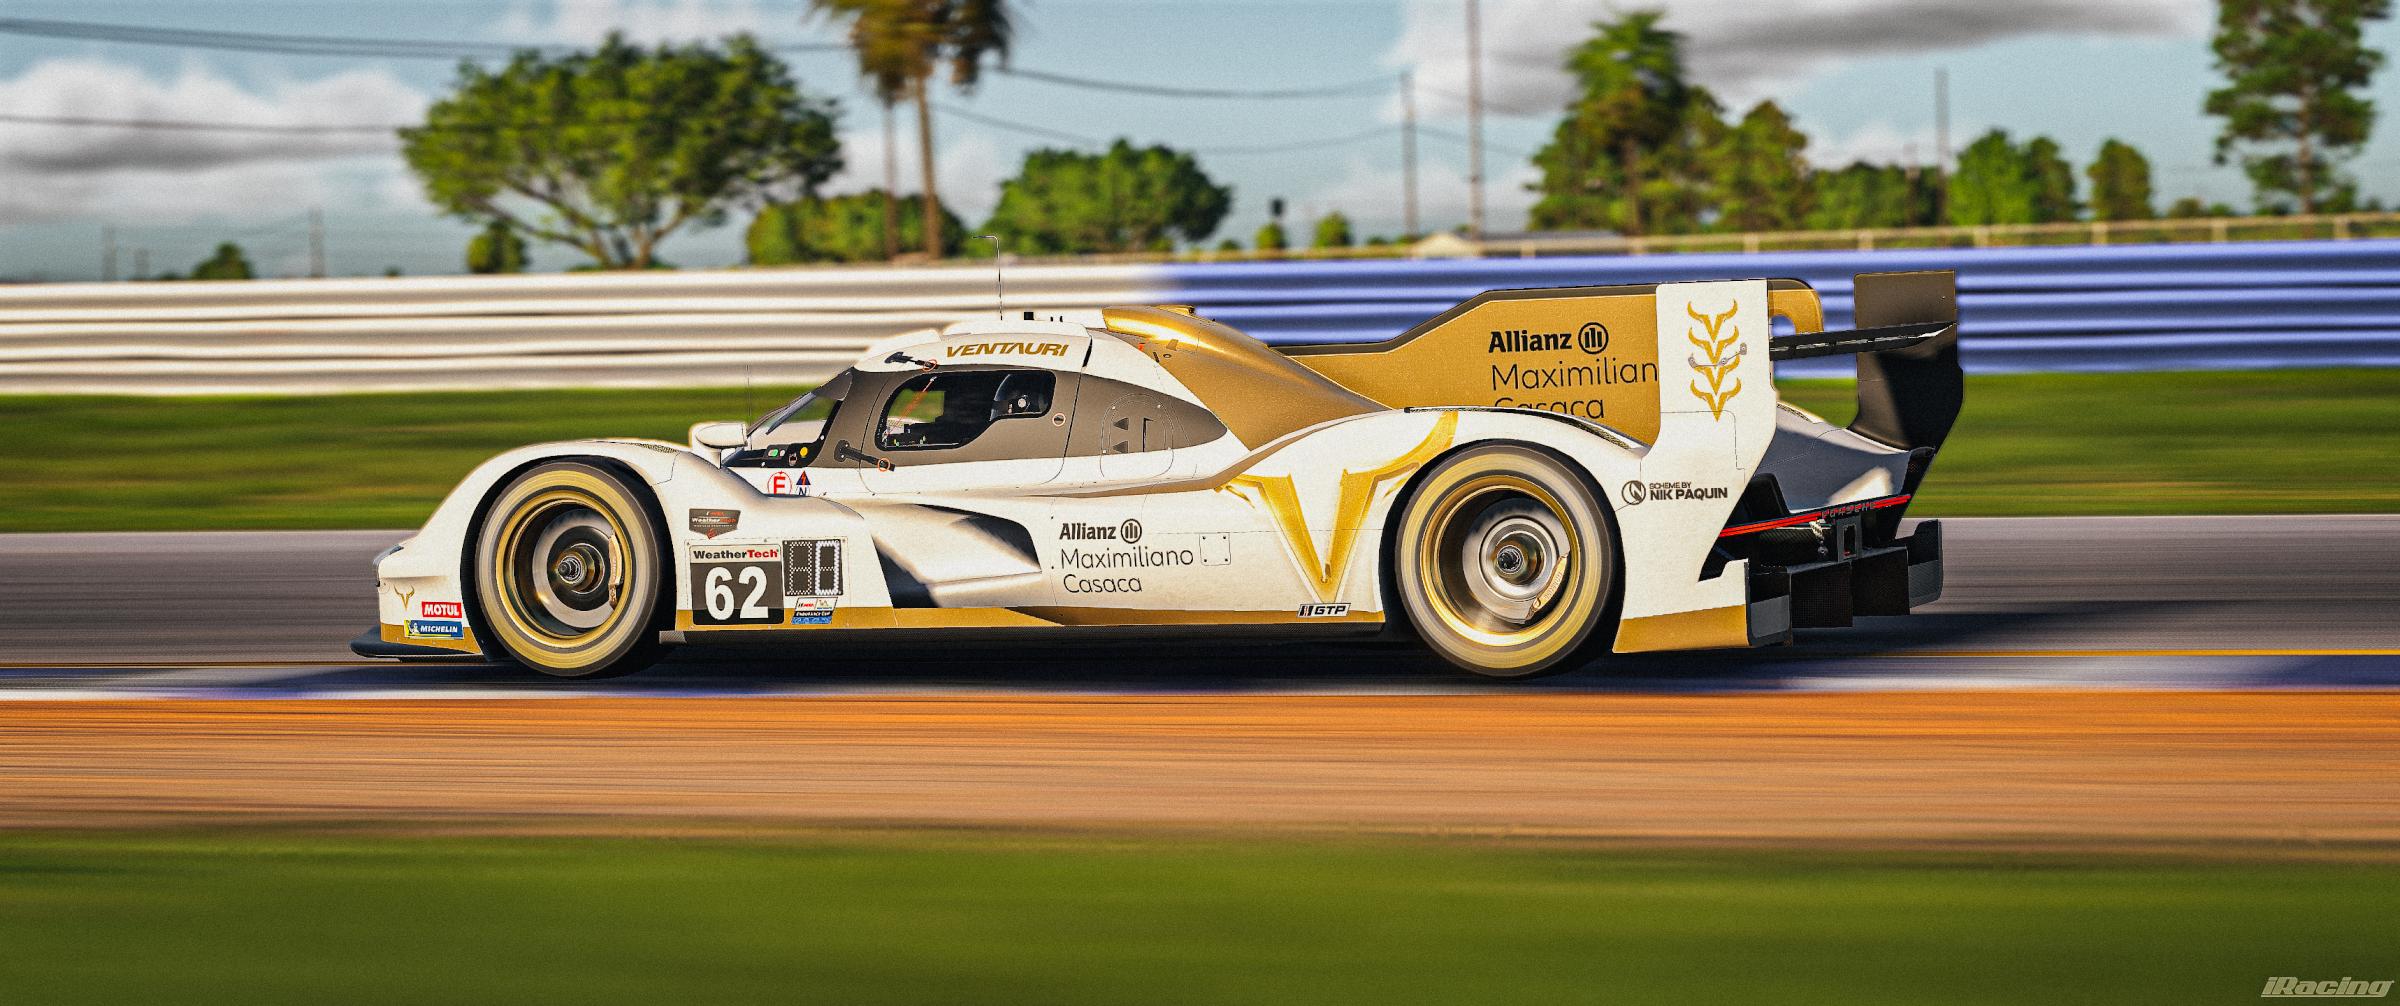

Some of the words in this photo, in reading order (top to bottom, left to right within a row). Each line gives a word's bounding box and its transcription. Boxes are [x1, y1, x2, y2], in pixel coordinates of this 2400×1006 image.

[1488, 329, 1573, 353] Allianz
[947, 342, 1069, 357] VENTAURI
[1681, 481, 1692, 489] BY
[1650, 489, 1673, 500] NIK
[1675, 487, 1728, 500] PAQUIN
[1059, 523, 1117, 540] Allianz
[693, 548, 778, 560] WeatherTech
[1060, 545, 1194, 569] Maximiliano
[1063, 573, 1143, 593] Casaca
[705, 566, 769, 621] 62
[423, 604, 460, 616] MOTUL
[1314, 605, 1347, 615] GTP
[420, 625, 458, 633] MICHELIN
